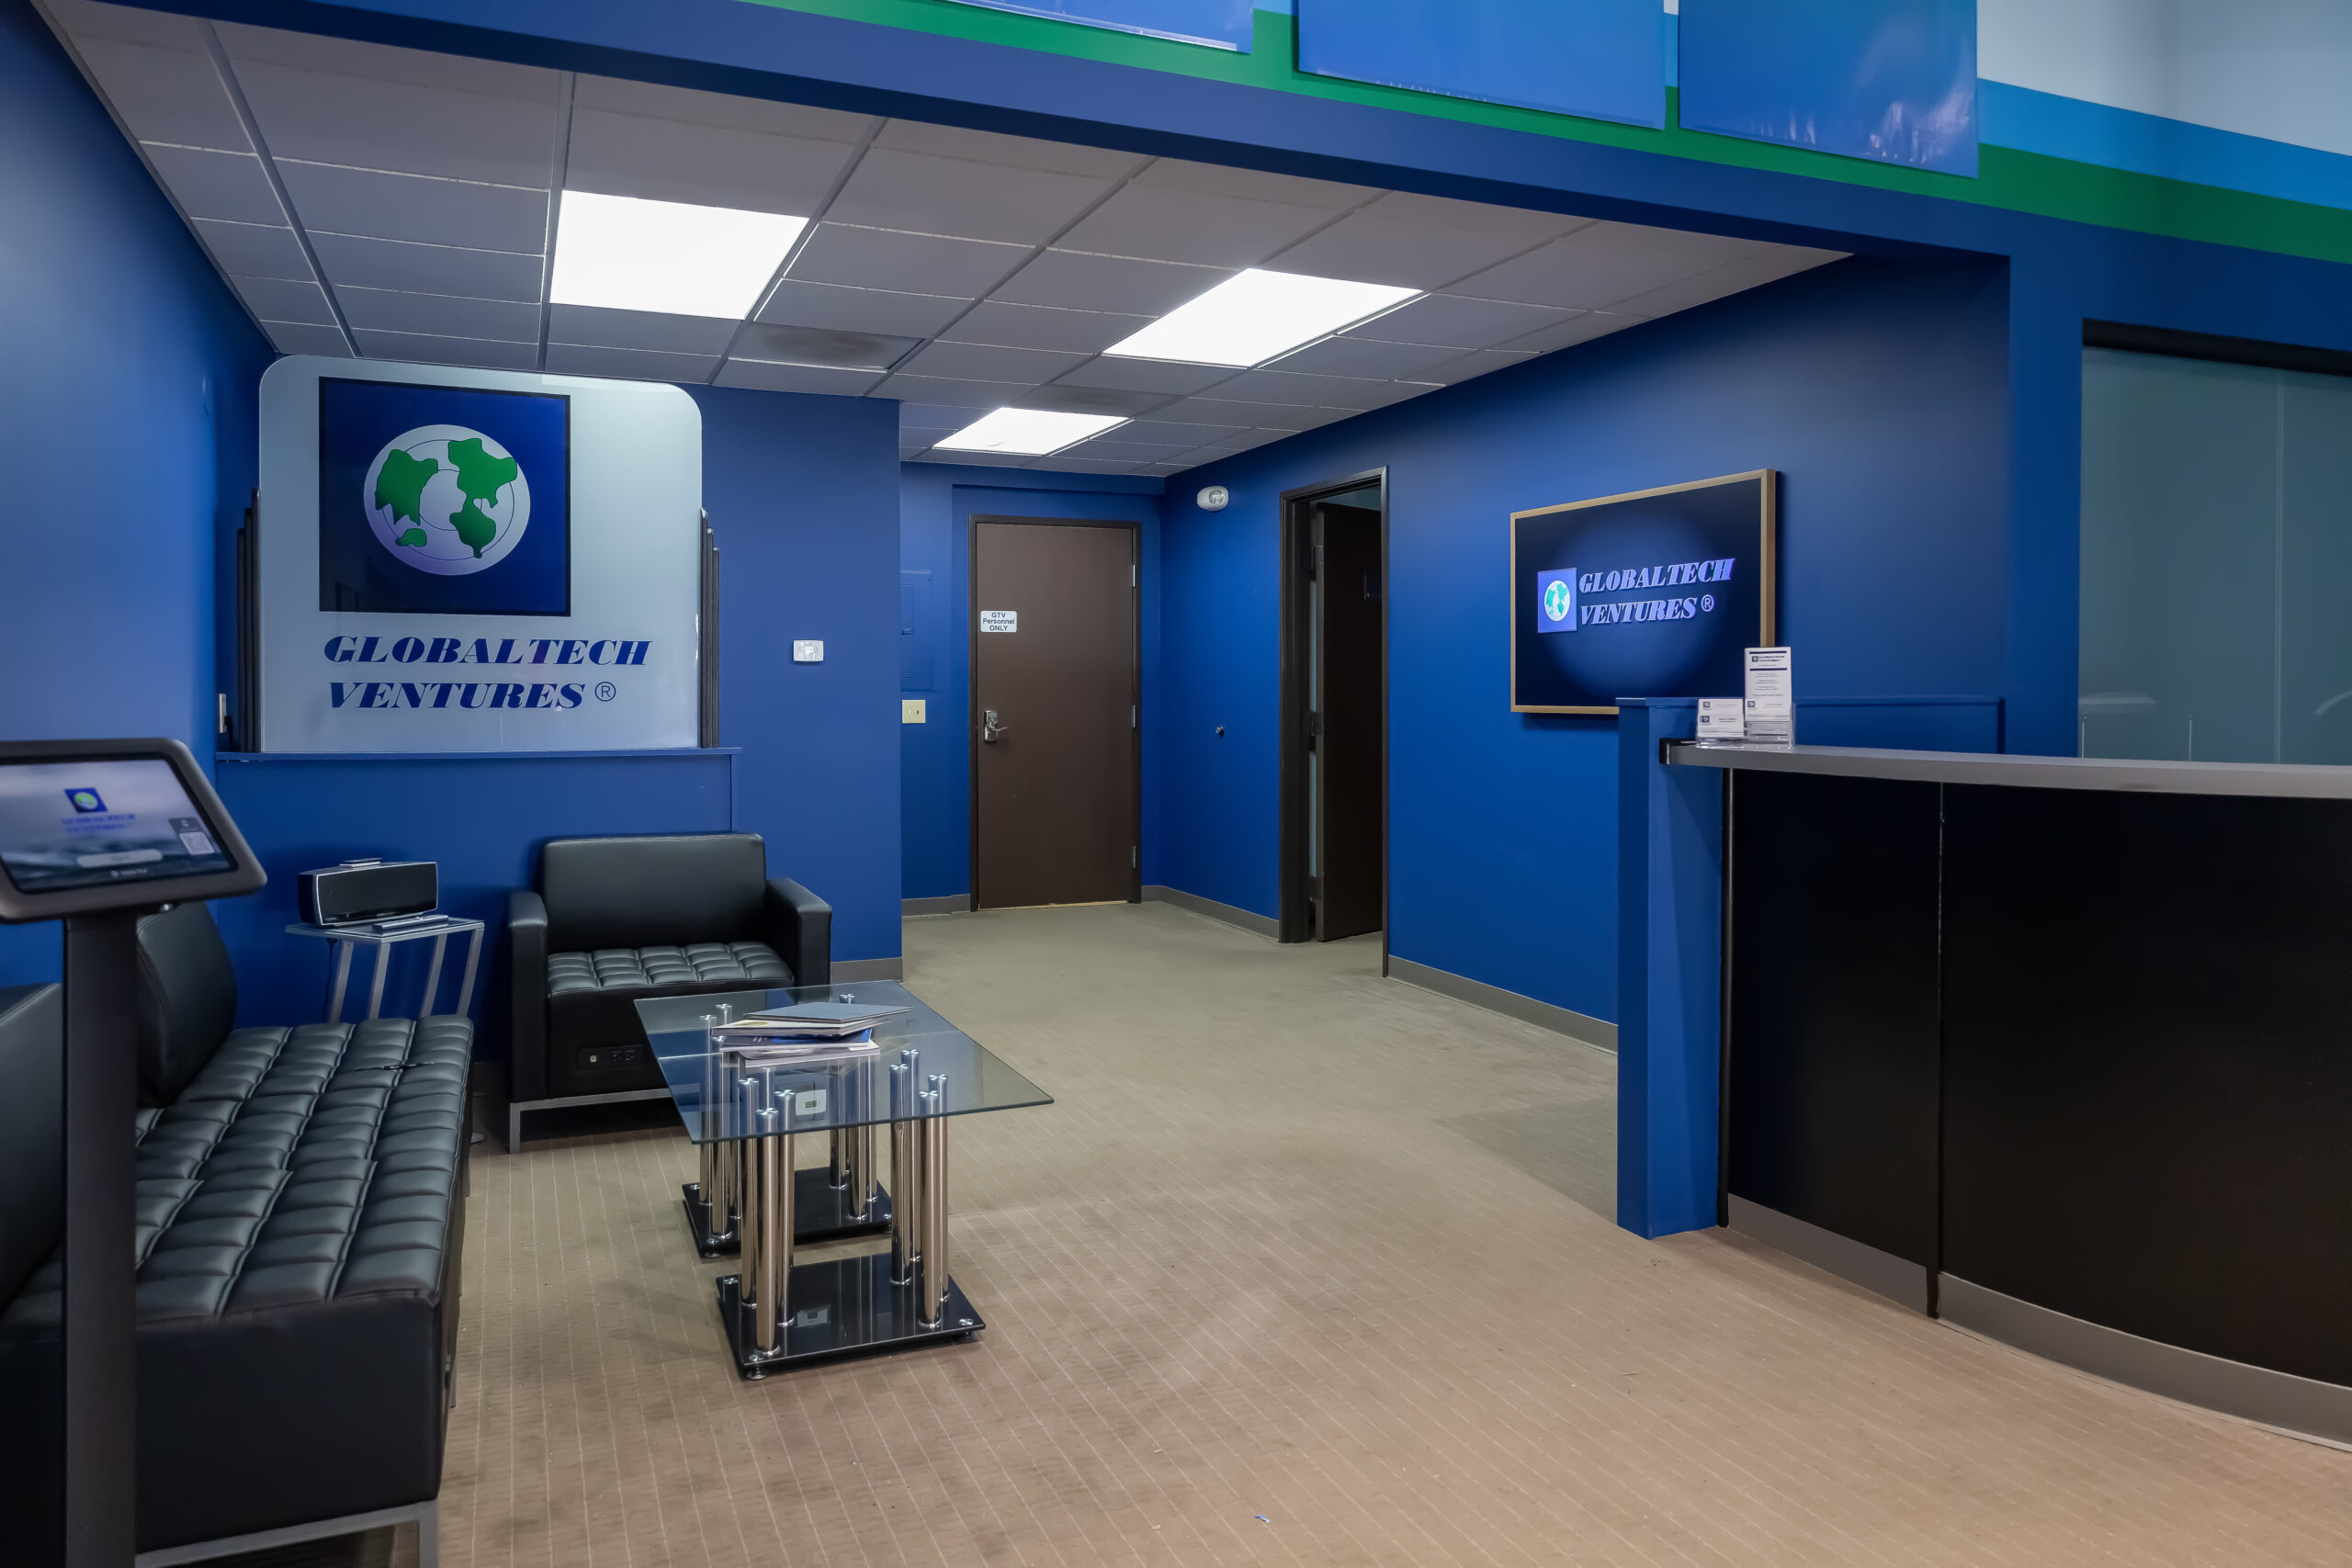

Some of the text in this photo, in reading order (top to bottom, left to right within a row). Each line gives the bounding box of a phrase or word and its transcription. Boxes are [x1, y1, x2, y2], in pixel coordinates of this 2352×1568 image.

[1578, 558, 1736, 593] GLOBALTECH
[1580, 597, 1698, 626] VENTURES
[323, 635, 653, 666] GLOBALTECH
[329, 681, 586, 709] VENTURES
